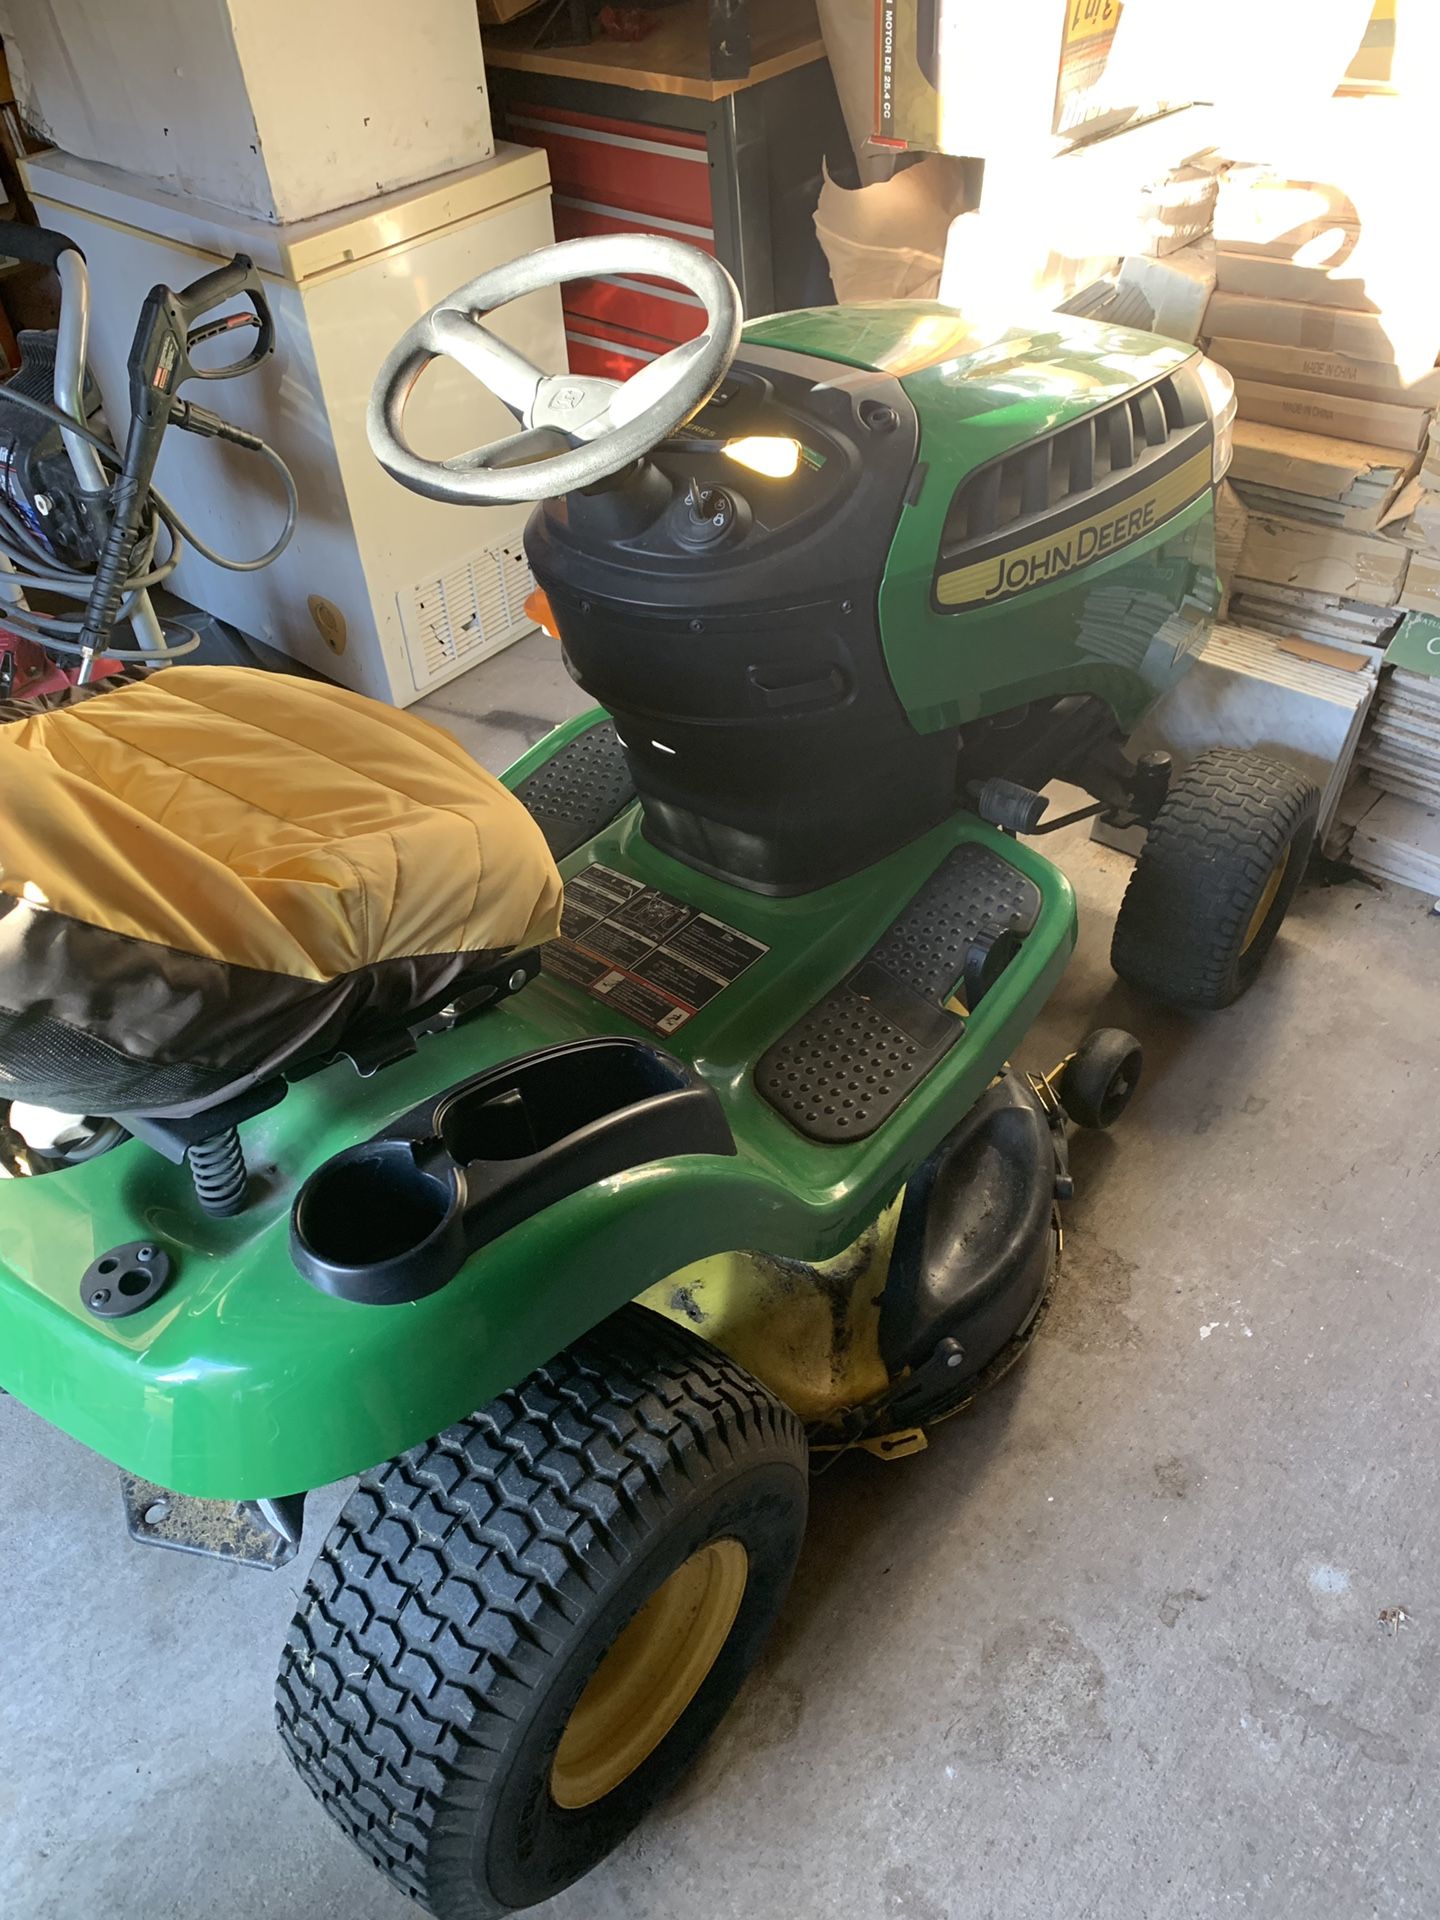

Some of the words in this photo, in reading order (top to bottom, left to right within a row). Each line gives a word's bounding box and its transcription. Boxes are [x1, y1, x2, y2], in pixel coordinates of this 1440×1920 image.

[884, 10, 893, 54] MOTOR
[884, 56, 892, 72] DE
[883, 75, 892, 99] 25.4
[883, 102, 891, 119] CC
[1302, 361, 1326, 376] MADE
[1325, 363, 1334, 377] IN
[1333, 366, 1357, 381] CHINA
[985, 541, 1072, 595] JOHN
[1077, 499, 1157, 560] DEERE
